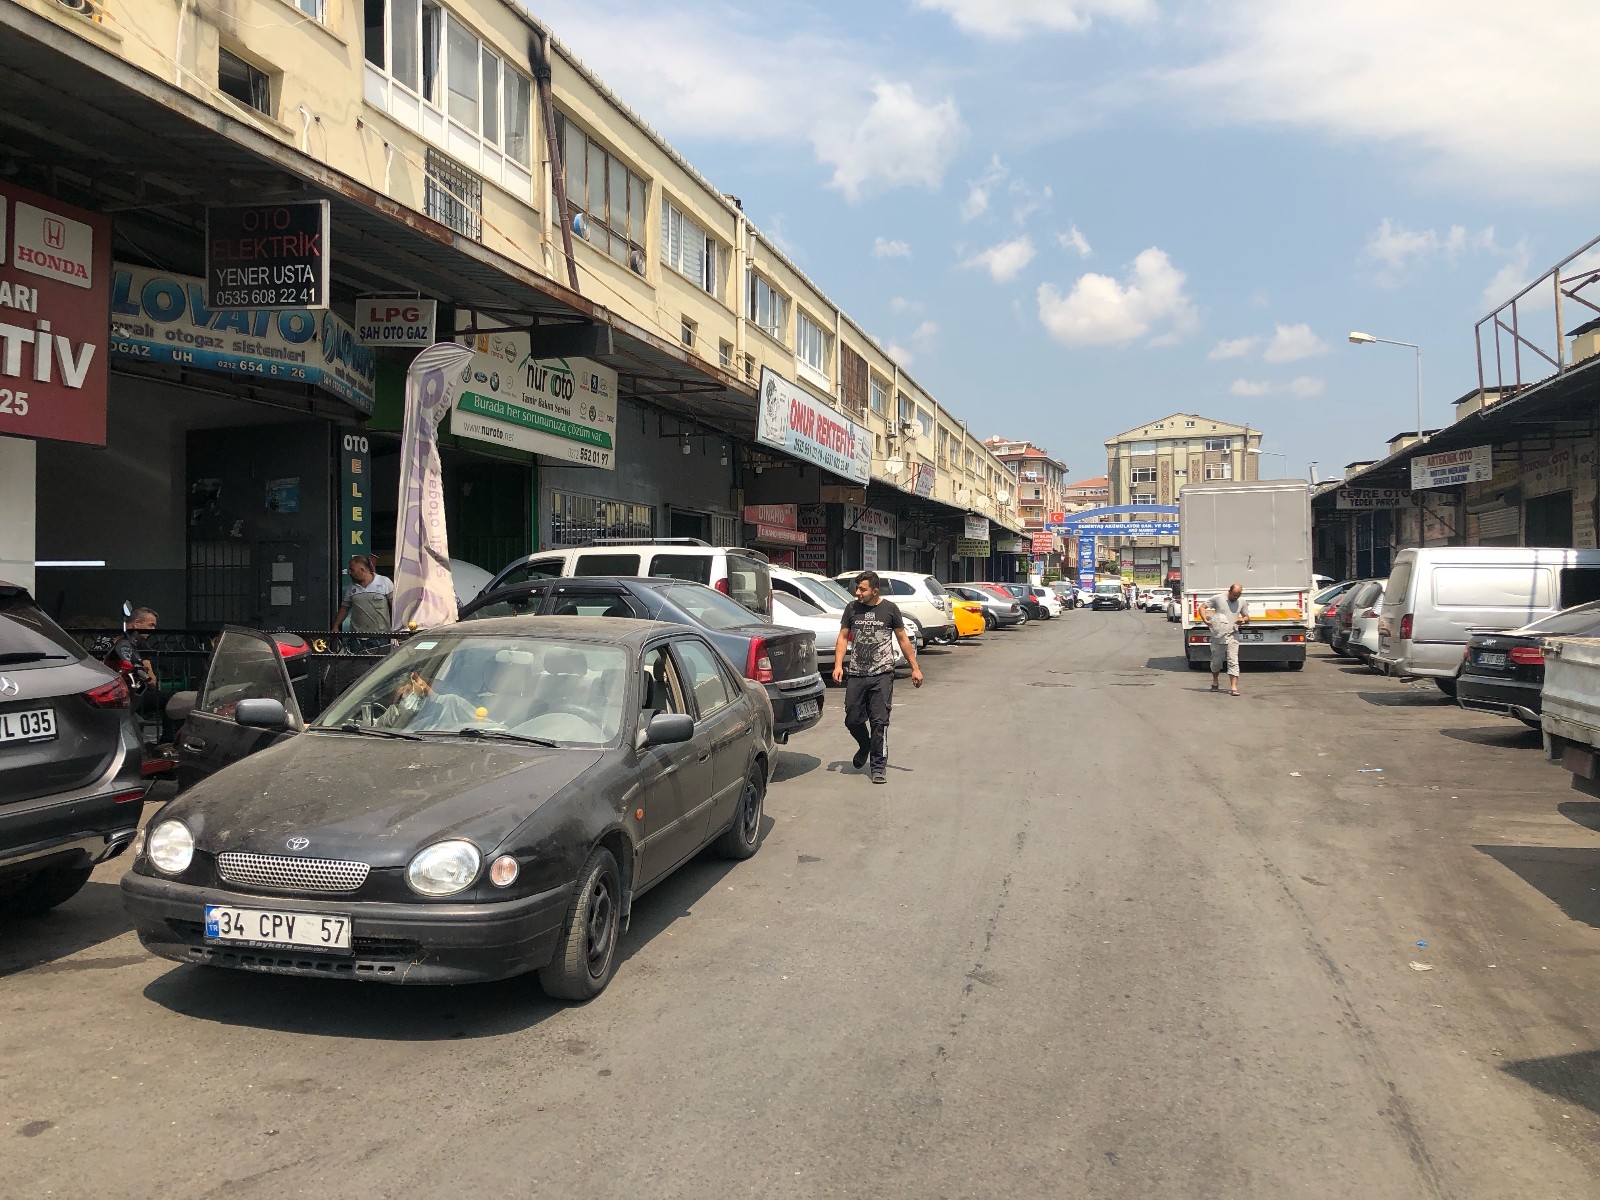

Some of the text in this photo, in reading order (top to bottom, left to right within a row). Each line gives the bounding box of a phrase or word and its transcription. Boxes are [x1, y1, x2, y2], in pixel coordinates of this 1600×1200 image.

[243, 207, 291, 231] OTO
[212, 232, 320, 260] ELEKTRİK
[18, 246, 88, 279] HONDA
[216, 265, 314, 287] YENER USTA
[217, 287, 315, 305] 0535 608 22 41
[371, 307, 419, 322] LPG
[166, 329, 223, 348] otogaz
[233, 340, 305, 363] sistemleri
[360, 326, 427, 342] ŞAH OTO GAZ
[218, 360, 236, 369] 0212
[239, 361, 263, 373] 654
[291, 367, 305, 379] 26
[527, 364, 547, 393] nur
[0, 388, 28, 416] 25
[474, 395, 504, 415] Burada
[507, 404, 521, 418] her
[523, 411, 566, 433] sorununuza
[790, 398, 815, 439] ONUR
[344, 434, 369, 453] OTO
[1459, 450, 1473, 462] OTO
[351, 458, 364, 558] ELEK
[1350, 498, 1373, 507] YEDEK
[855, 619, 885, 627] concrete
[0, 711, 52, 738] L 035
[220, 912, 244, 936] 34
[260, 914, 296, 939] CPV
[321, 919, 345, 944] 57
